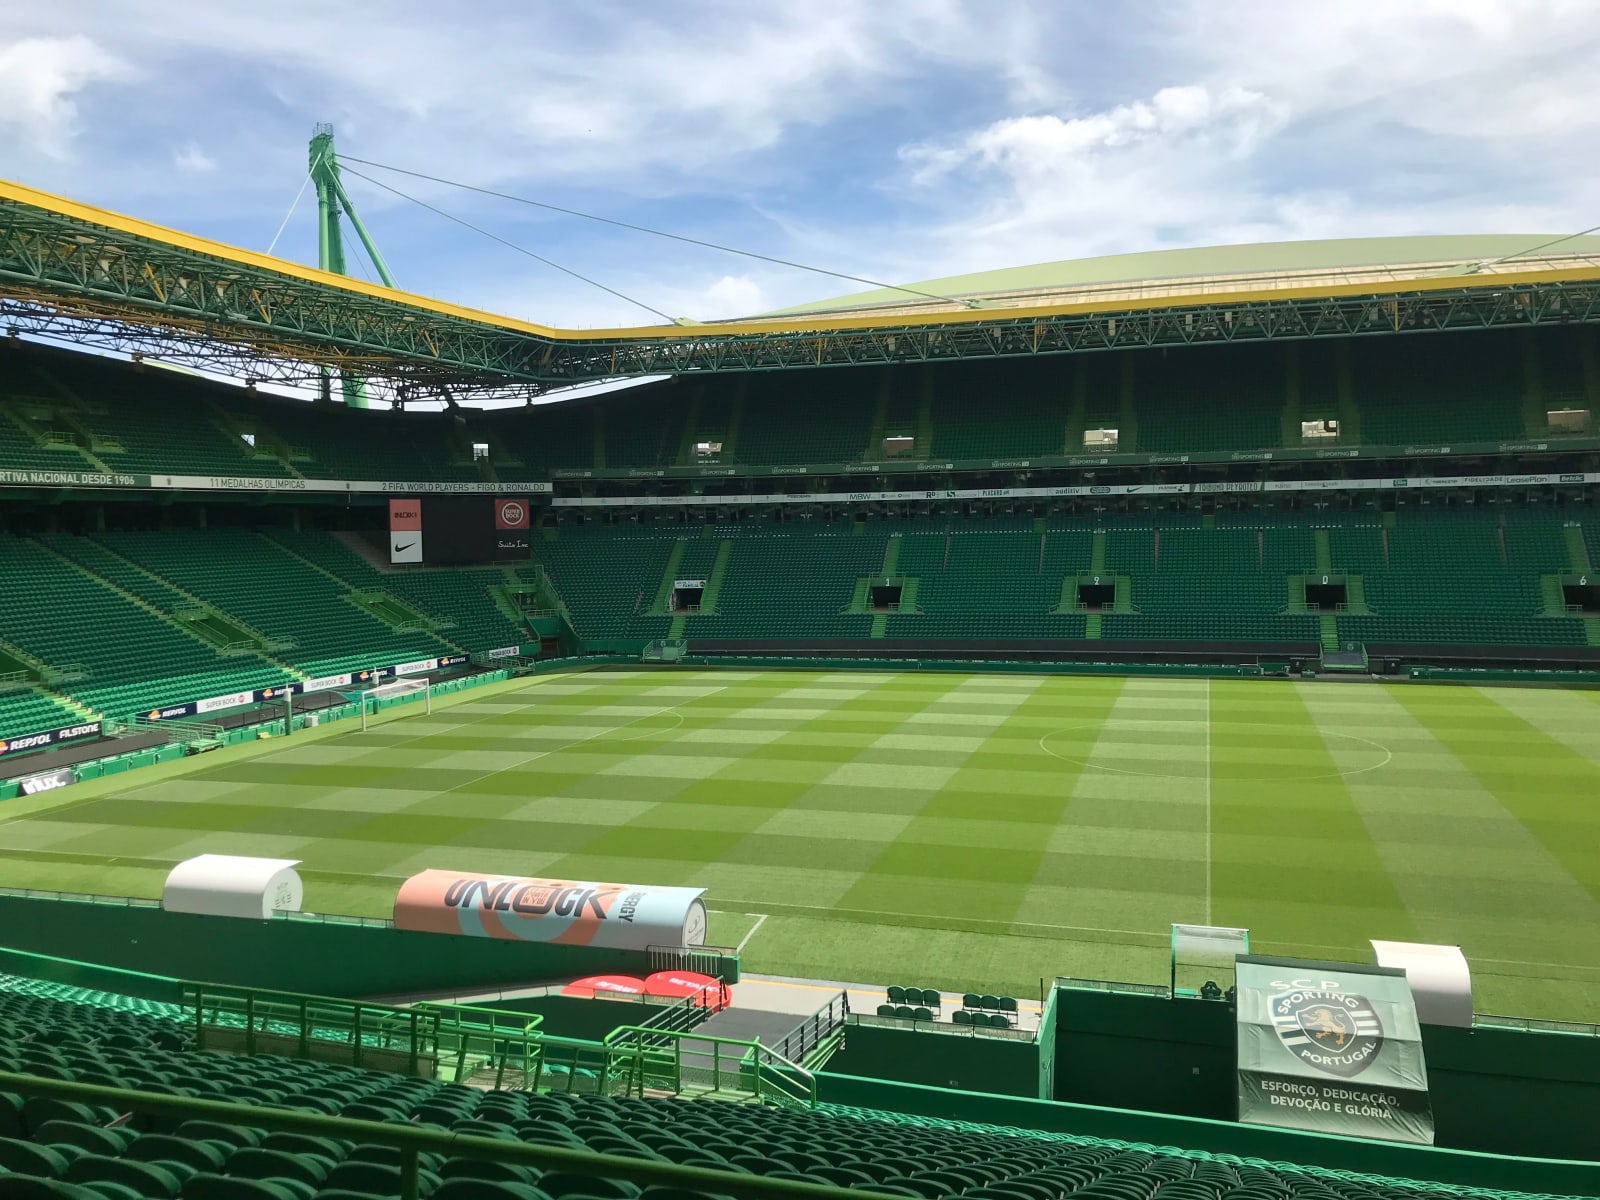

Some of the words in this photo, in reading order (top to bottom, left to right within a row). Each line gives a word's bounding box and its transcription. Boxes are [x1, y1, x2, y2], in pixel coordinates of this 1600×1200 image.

[30, 473, 79, 483] NACIONAL
[82, 474, 112, 484] DESDE
[114, 476, 135, 485] 1906
[210, 478, 219, 487] 11
[221, 479, 263, 488] MEDALHAS
[1580, 576, 1586, 585] 6
[325, 678, 337, 686] BOCK
[206, 700, 221, 708] SUPER
[222, 698, 236, 706] BOCK
[10, 734, 51, 750] REPSOL
[59, 724, 98, 738] FILSTONE
[444, 880, 617, 920] UNLOCK
[1277, 990, 1360, 1015] SPORTING
[1301, 1041, 1376, 1066] PORTUGAL
[1261, 1080, 1319, 1097] ESFORÇO,
[1323, 1087, 1400, 1107] DEDICAÇÃO,
[1271, 1094, 1330, 1112] DEVOÇÃO
[1334, 1103, 1342, 1113] E
[1345, 1102, 1392, 1120] GLÓRIA
